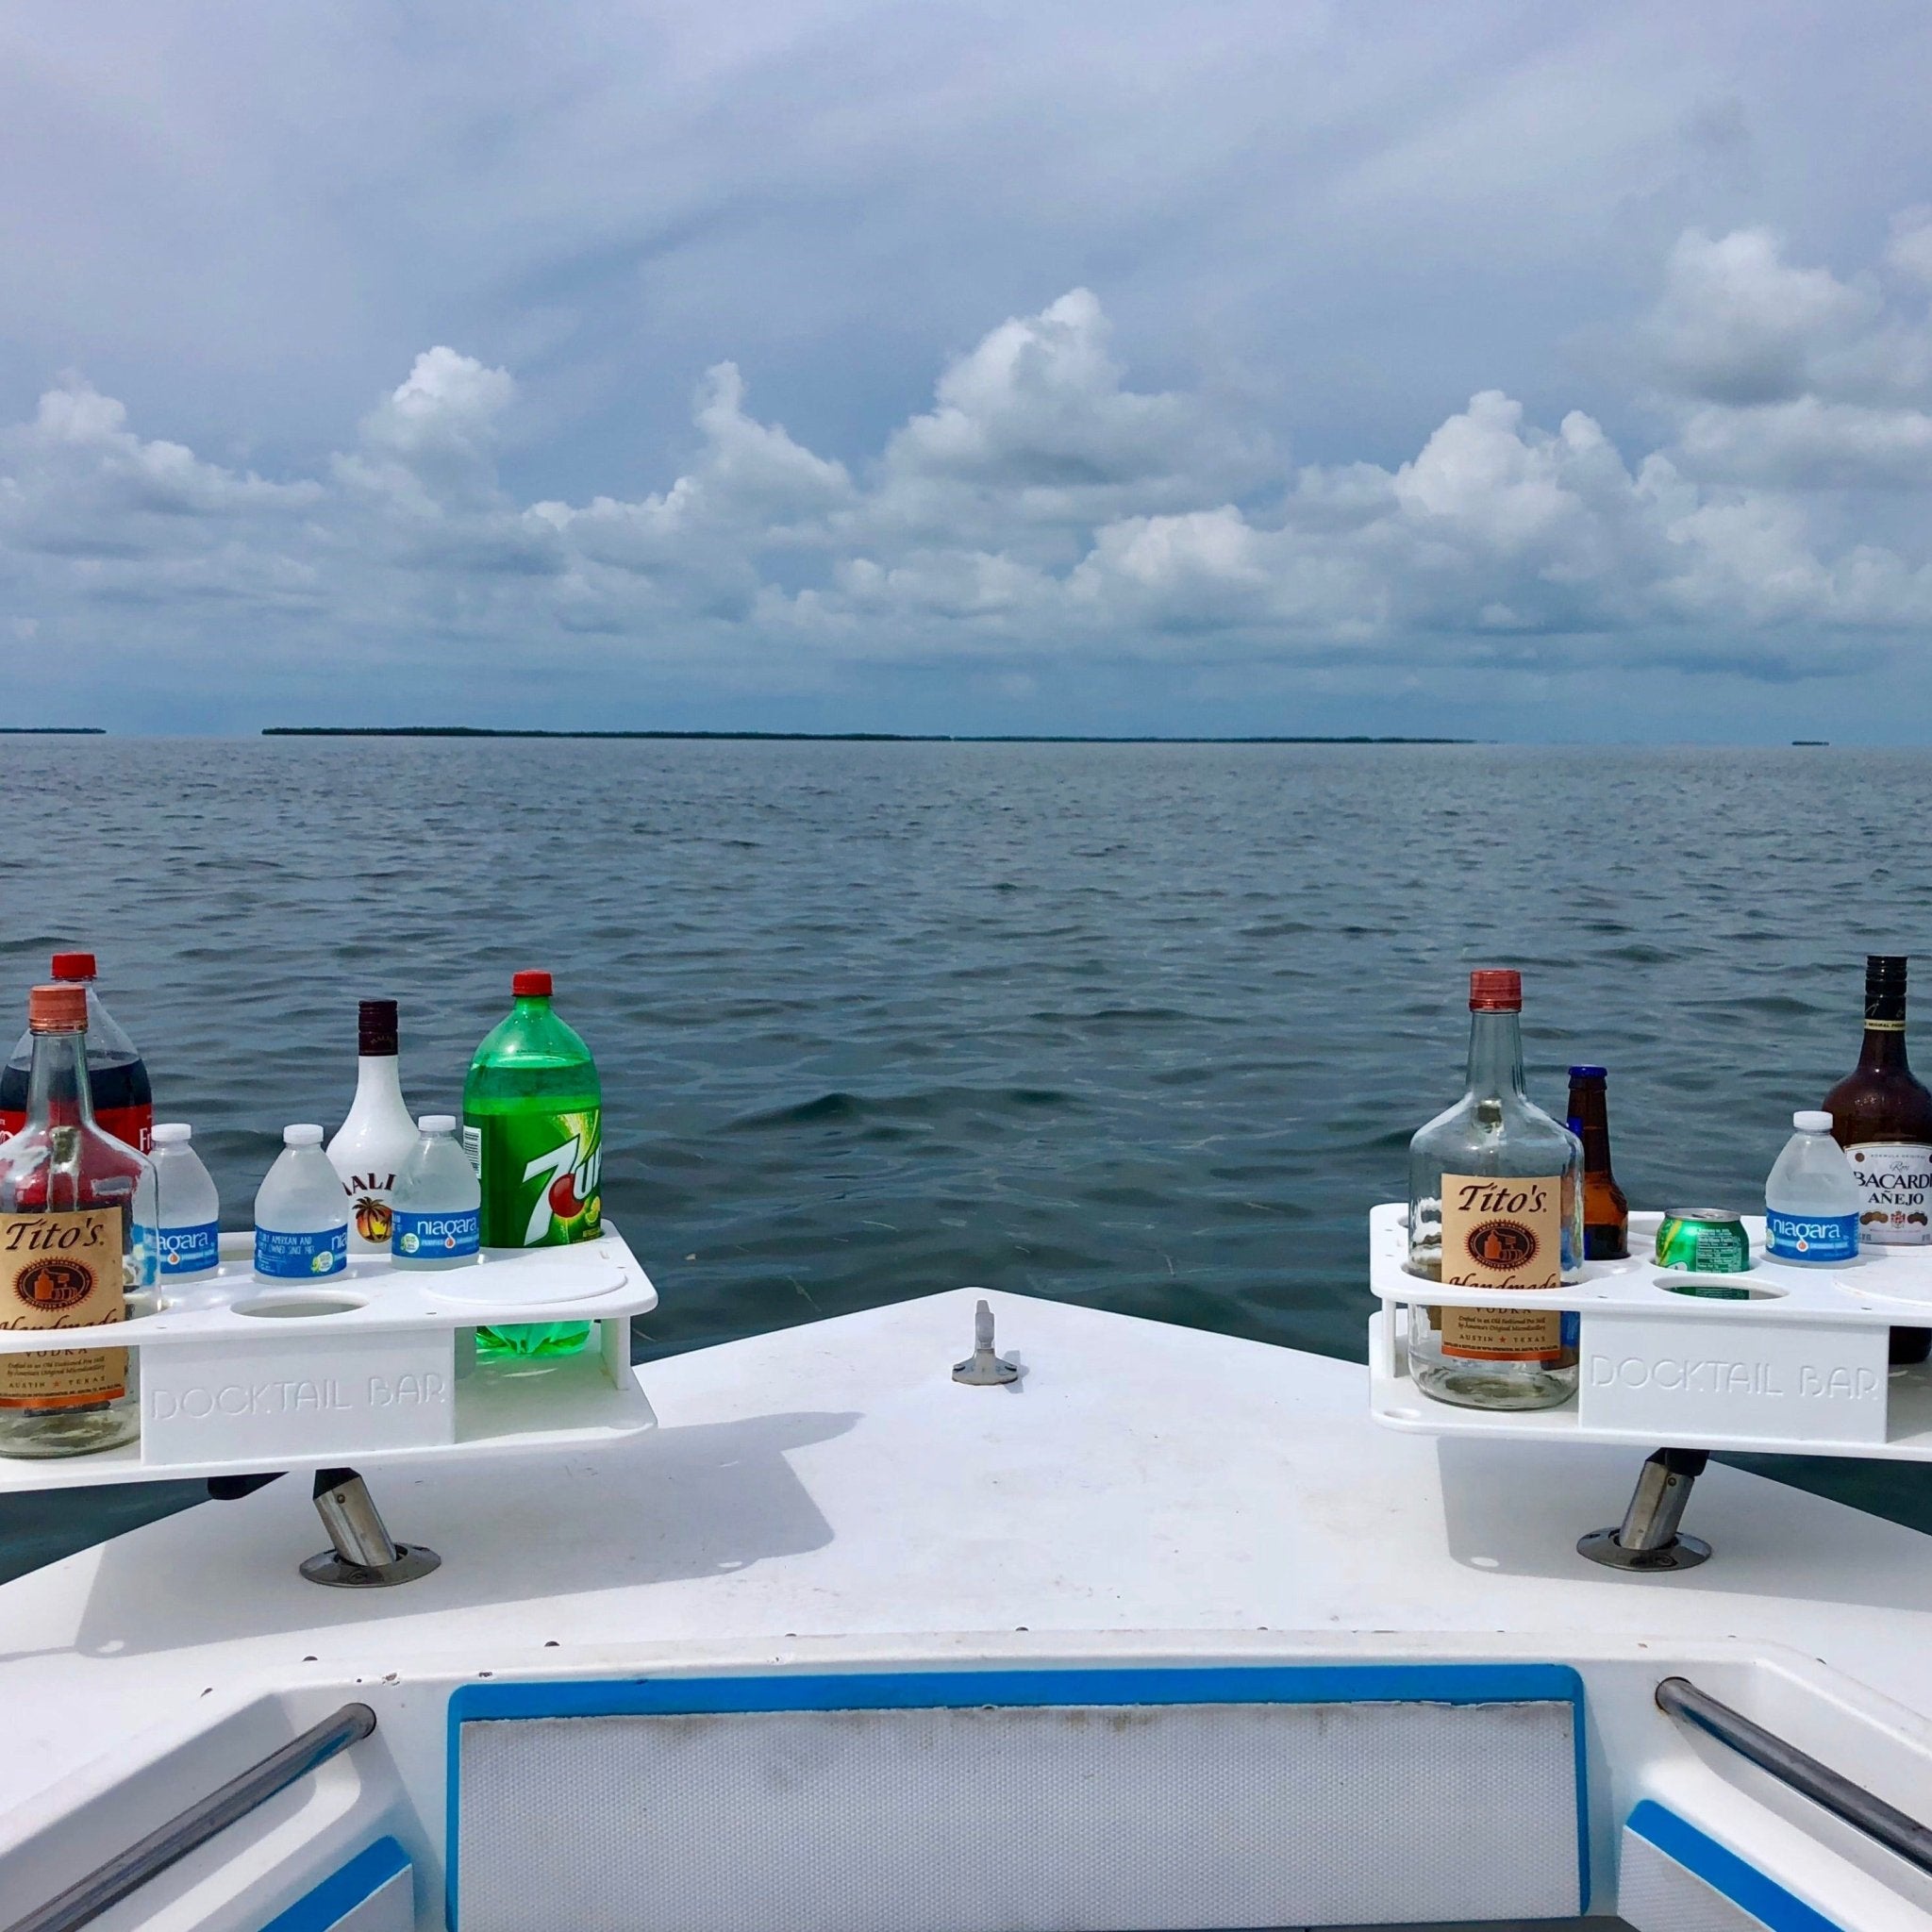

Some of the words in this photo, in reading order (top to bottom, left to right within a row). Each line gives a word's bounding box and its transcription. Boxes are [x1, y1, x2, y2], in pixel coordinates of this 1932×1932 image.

[341, 1173, 397, 1196] ALI
[1868, 1190, 1924, 1206] AÑEJO
[417, 1217, 477, 1241] niagara
[1774, 1219, 1840, 1242] niagara
[158, 1231, 208, 1255] agara
[1459, 1334, 1493, 1342] AUSTIN
[1591, 1355, 1784, 1396] DOCKTAIL
[1799, 1365, 1878, 1401] BAR
[151, 1378, 353, 1421] DOCKTAIL
[368, 1373, 446, 1408] BAR
